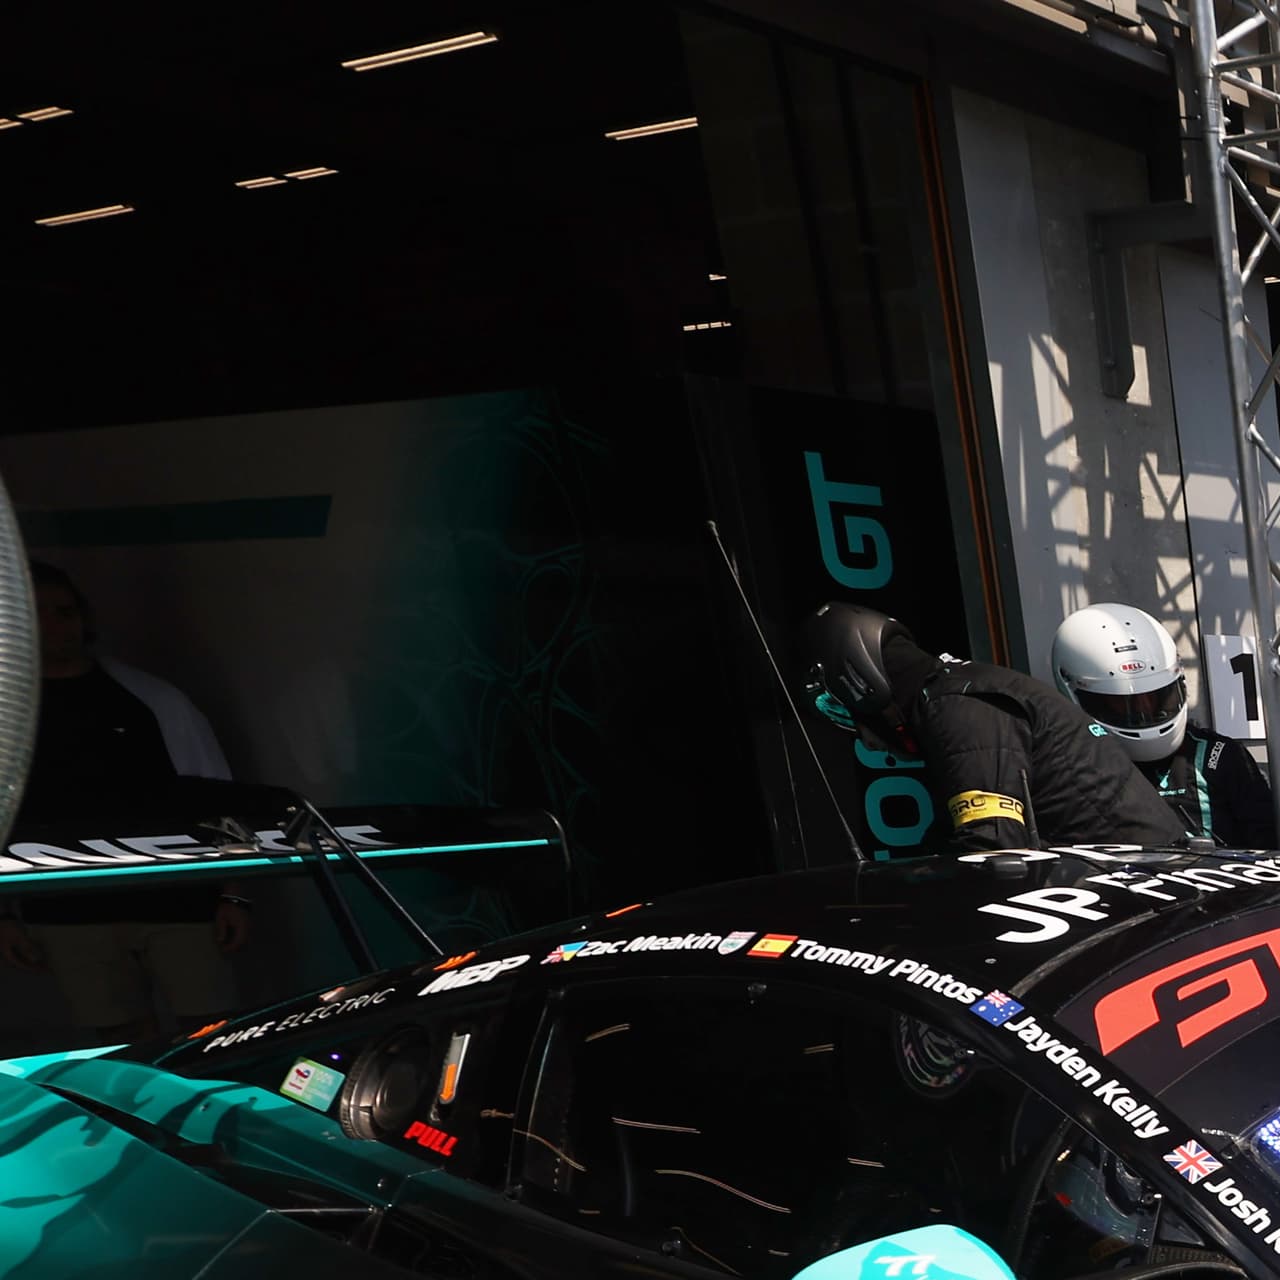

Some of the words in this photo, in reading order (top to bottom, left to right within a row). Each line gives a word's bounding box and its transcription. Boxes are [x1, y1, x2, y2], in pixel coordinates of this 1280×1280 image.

[804, 451, 893, 590] GT
[1121, 661, 1144, 672] BELL
[580, 937, 625, 957] Zac
[628, 931, 722, 953] Meakin
[977, 887, 1110, 944] JP
[417, 954, 530, 997] MBP
[789, 939, 896, 977] Tommy
[895, 958, 983, 1005] Pintos
[203, 1021, 273, 1054] PURE
[274, 988, 397, 1032] ELECTRIC
[1003, 1012, 1102, 1094] Jayden
[1091, 1081, 1171, 1140] Kelly
[403, 1120, 460, 1157] PULL
[1202, 1176, 1272, 1240] Josh
